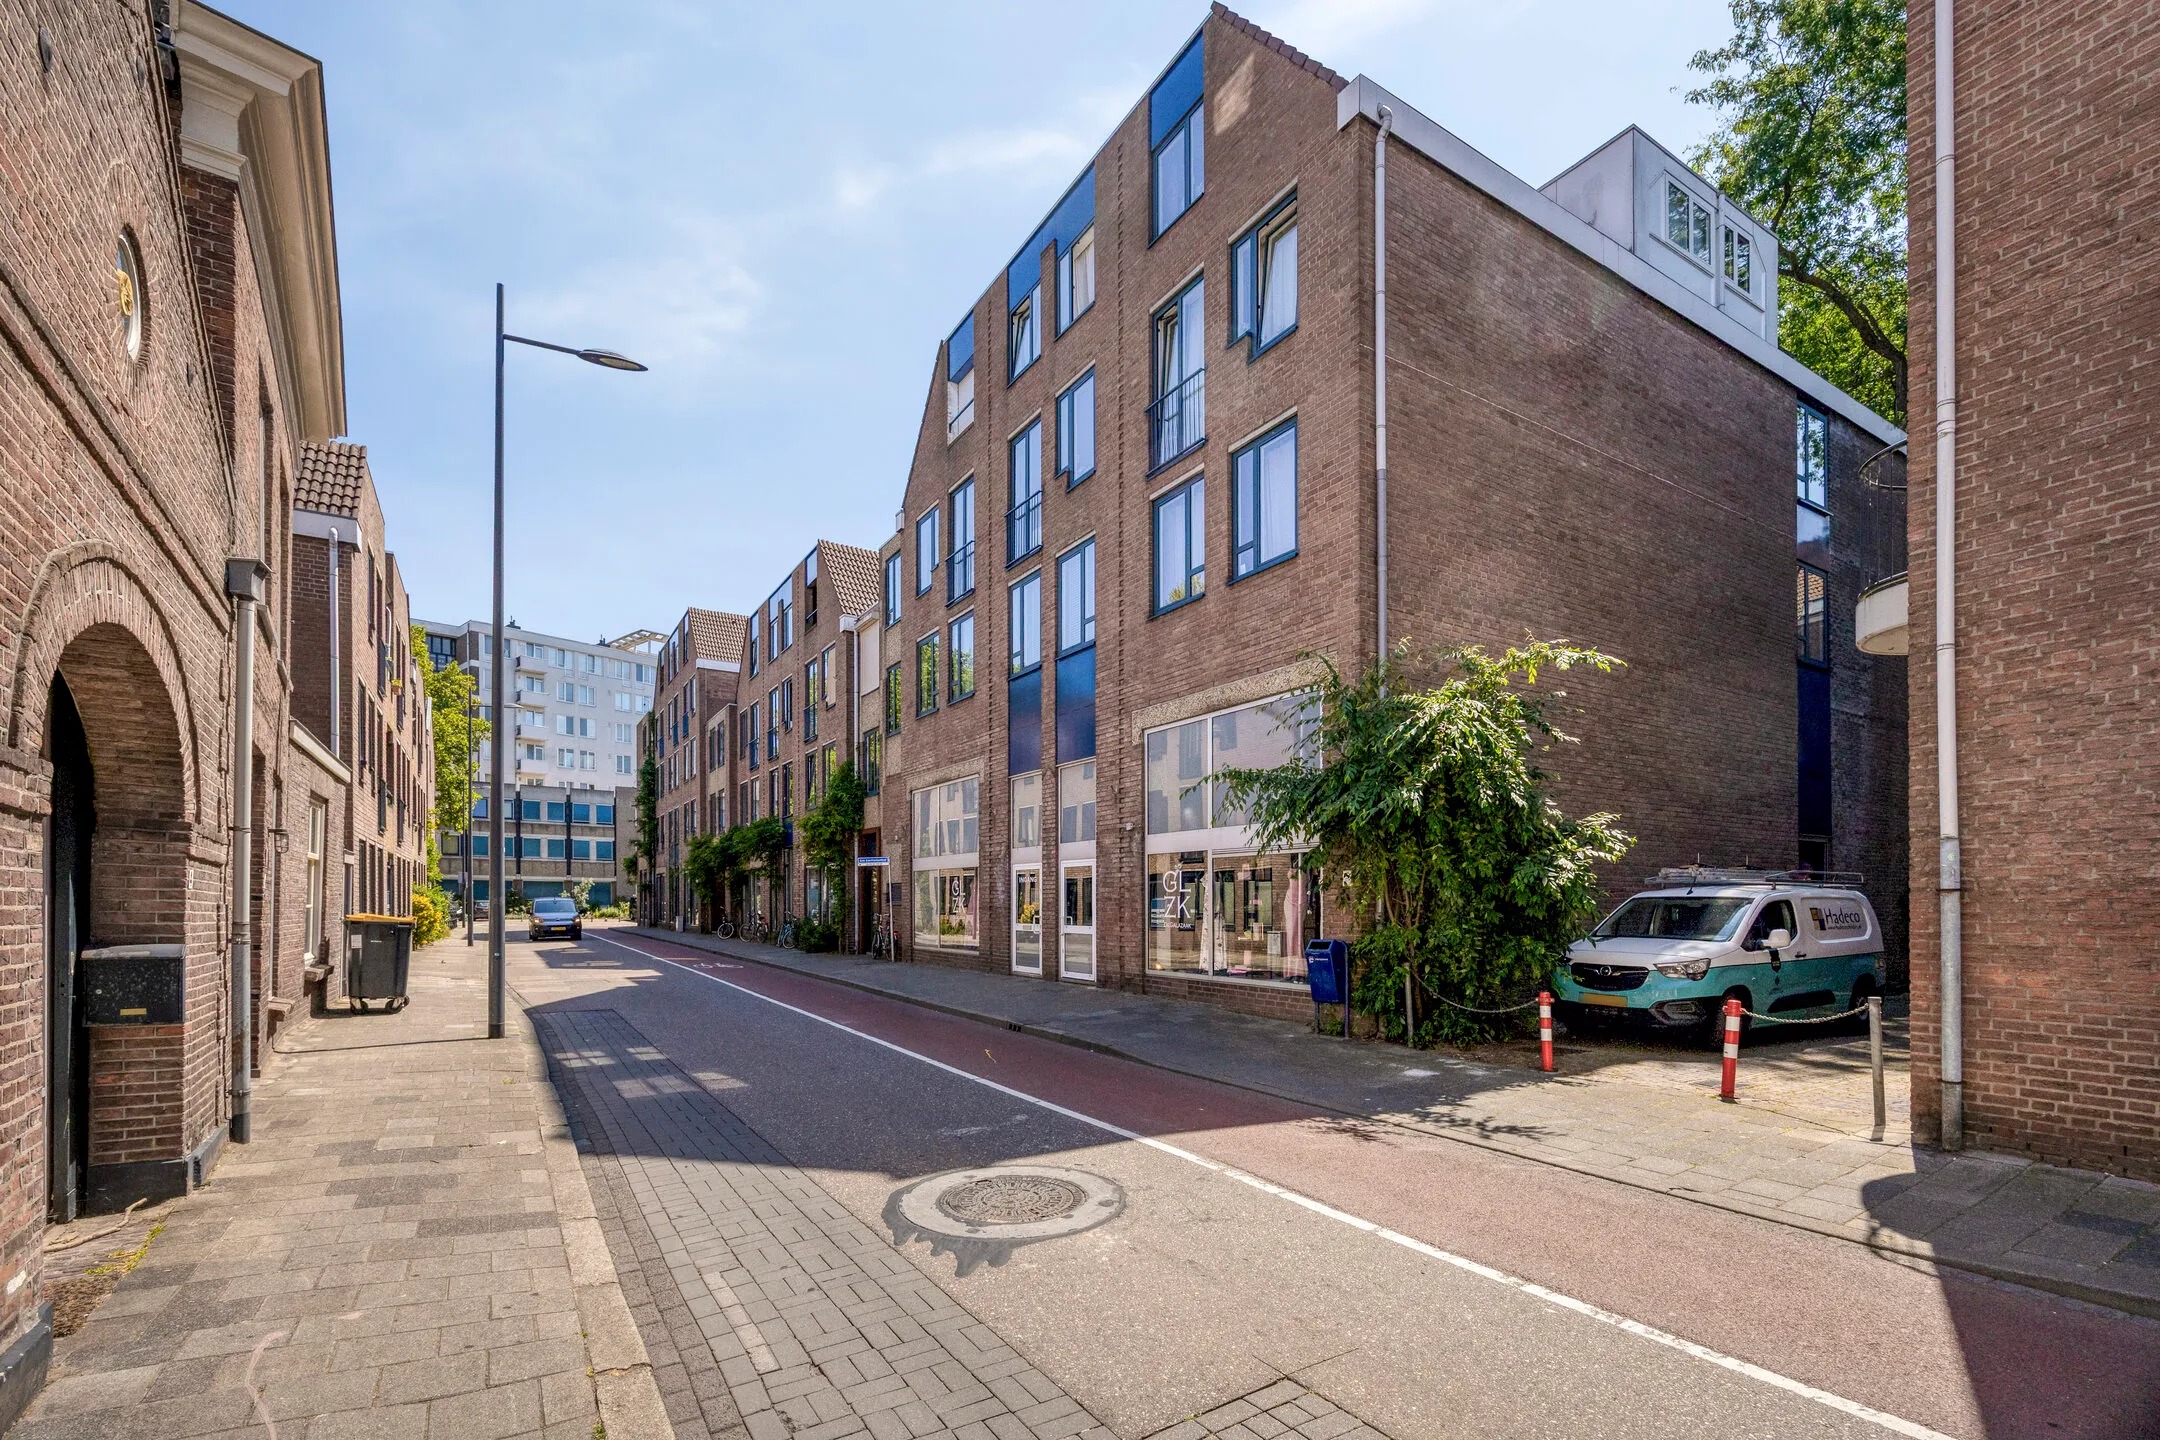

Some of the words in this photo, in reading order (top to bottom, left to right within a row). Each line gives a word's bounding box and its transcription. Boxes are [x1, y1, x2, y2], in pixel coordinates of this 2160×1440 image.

[952, 879, 965, 895] GL
[1163, 870, 1191, 892] GL
[952, 898, 966, 913] ZK
[1164, 896, 1191, 918] ZK
[1824, 906, 1860, 924] Hadeco
